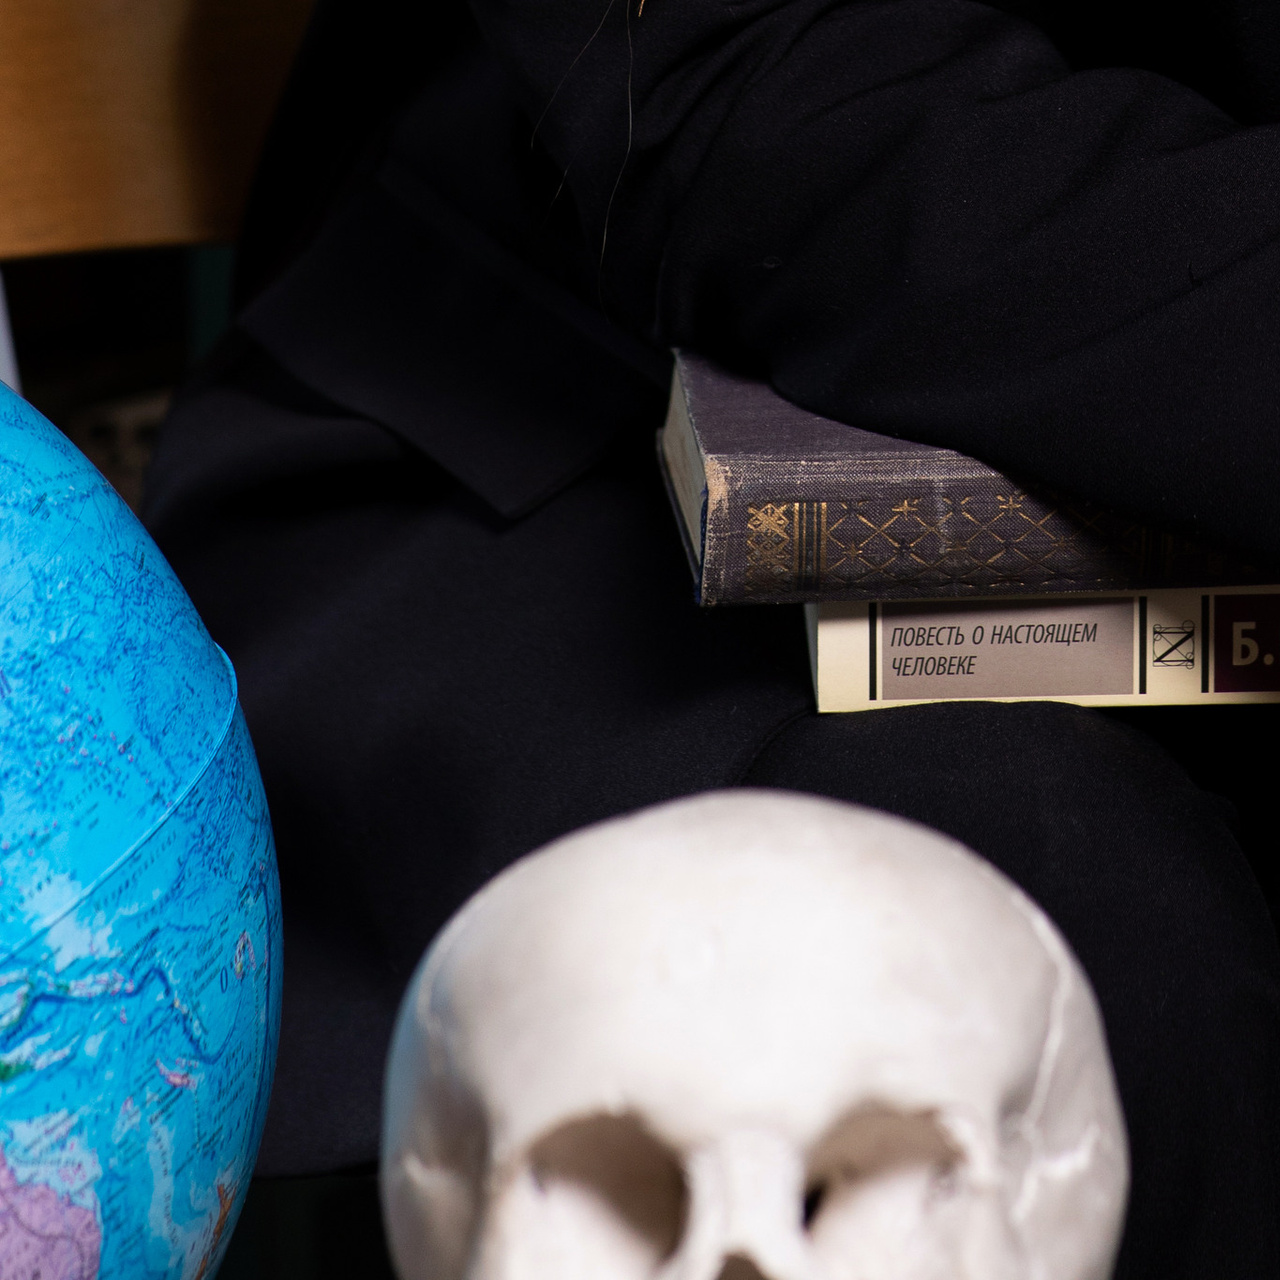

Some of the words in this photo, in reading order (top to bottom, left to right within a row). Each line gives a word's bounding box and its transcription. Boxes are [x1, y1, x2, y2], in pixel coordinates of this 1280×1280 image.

[891, 626, 965, 647] ПОВЕСТЬ
[972, 625, 984, 645] О
[990, 623, 1098, 646] НАСТОЯЩЕМ
[892, 655, 977, 676] ЧЕЛОВЕКЕ
